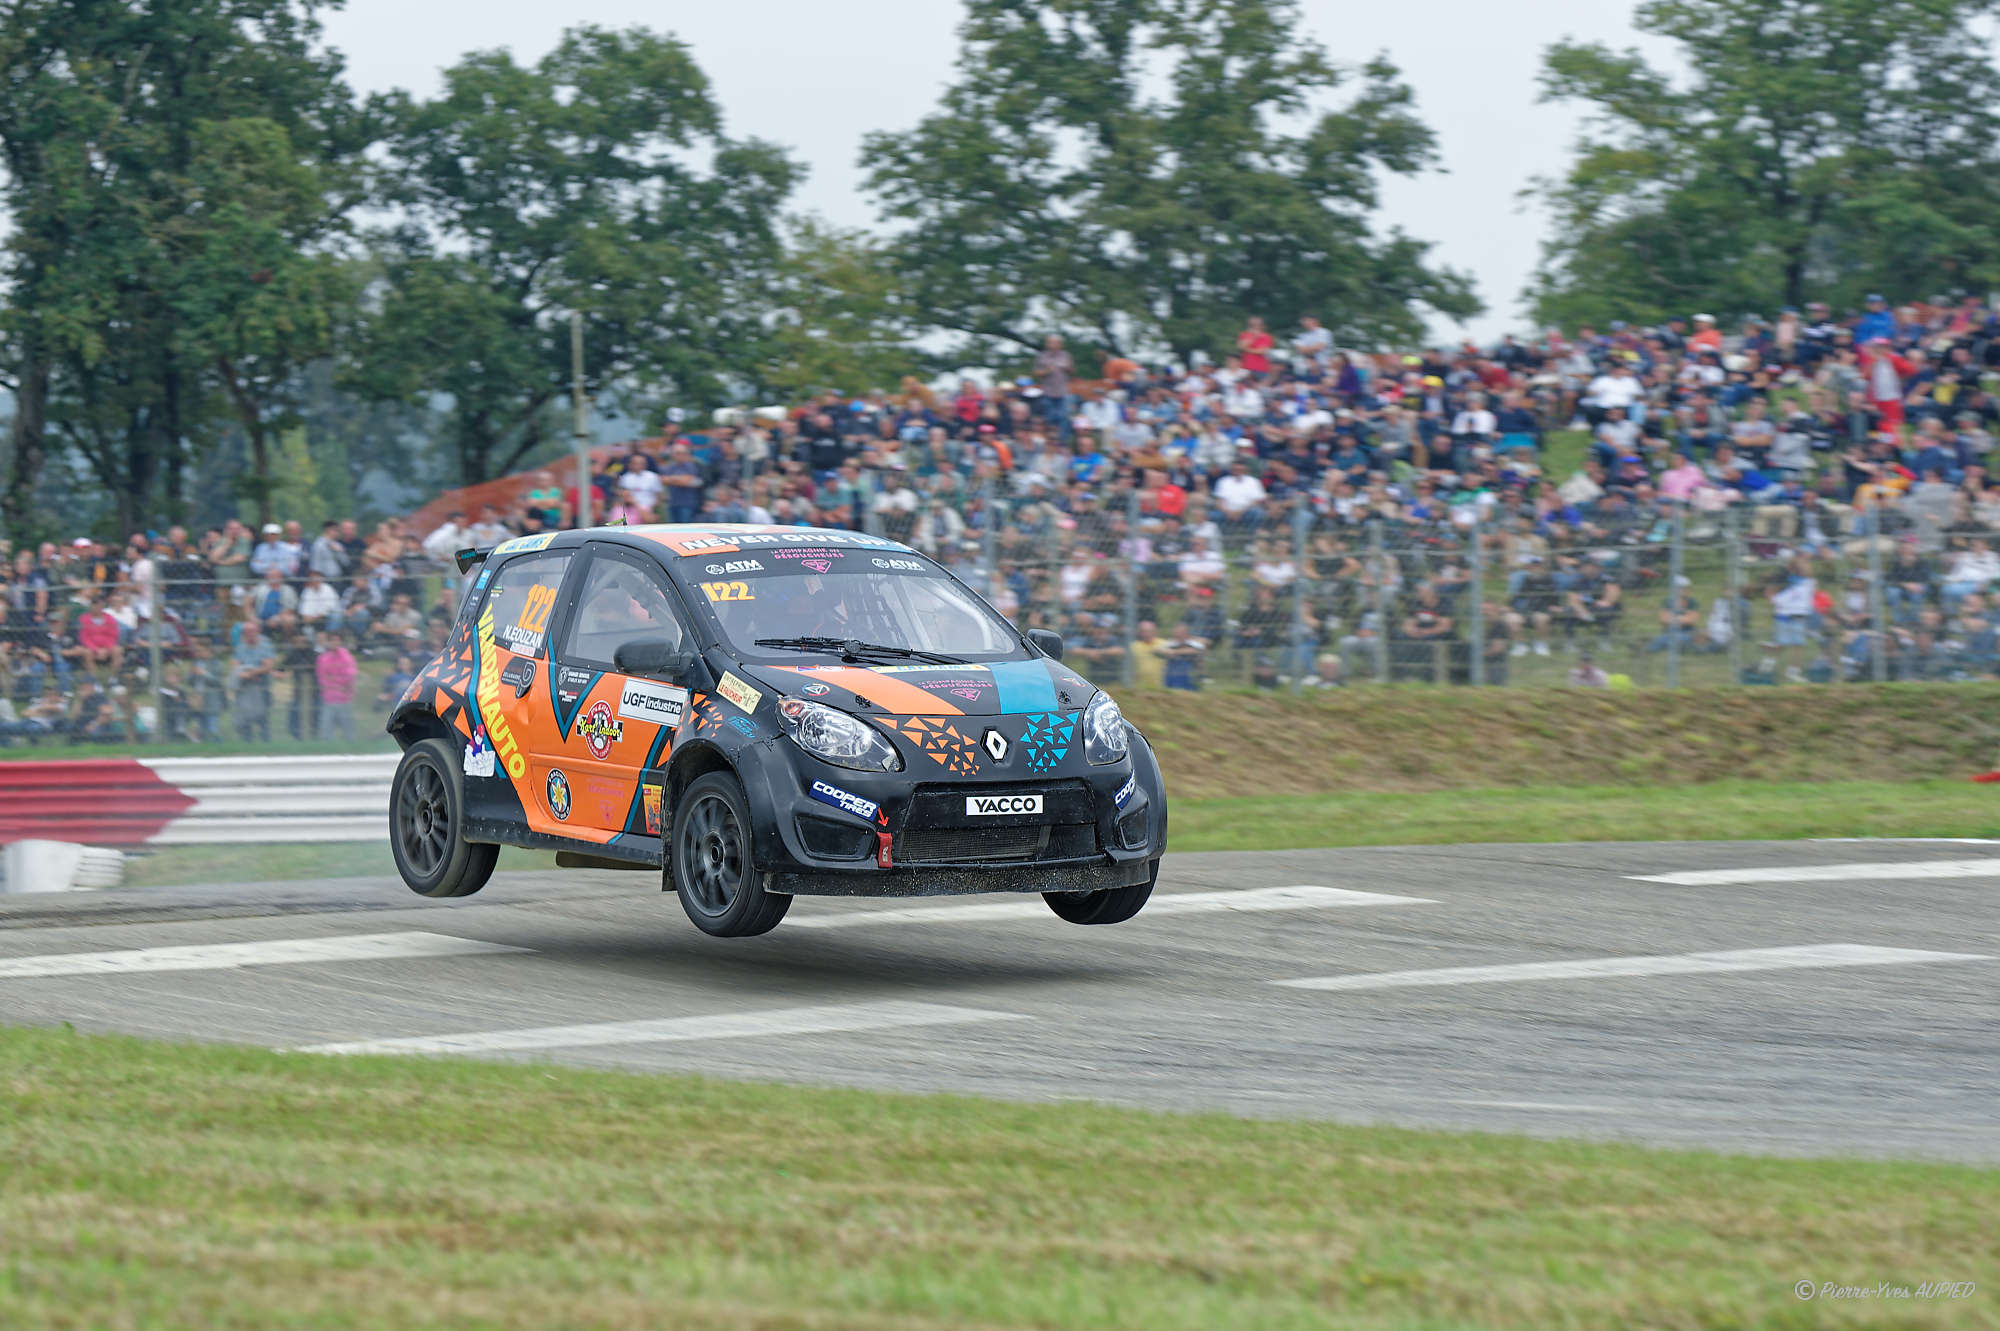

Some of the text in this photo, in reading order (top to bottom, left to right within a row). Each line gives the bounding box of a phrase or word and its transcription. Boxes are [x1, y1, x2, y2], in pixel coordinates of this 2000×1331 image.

[680, 535, 779, 550] NEVER
[781, 534, 848, 543] GIVE
[725, 559, 764, 572] ATM
[889, 559, 926, 571] ATM
[700, 581, 756, 602] 122
[517, 584, 558, 634] 122
[477, 601, 526, 779] VANDENAUTO
[623, 691, 682, 714] UGF industrie
[812, 780, 877, 812] COOPER
[974, 797, 1036, 813] YACCO
[839, 800, 873, 818] TIRES
